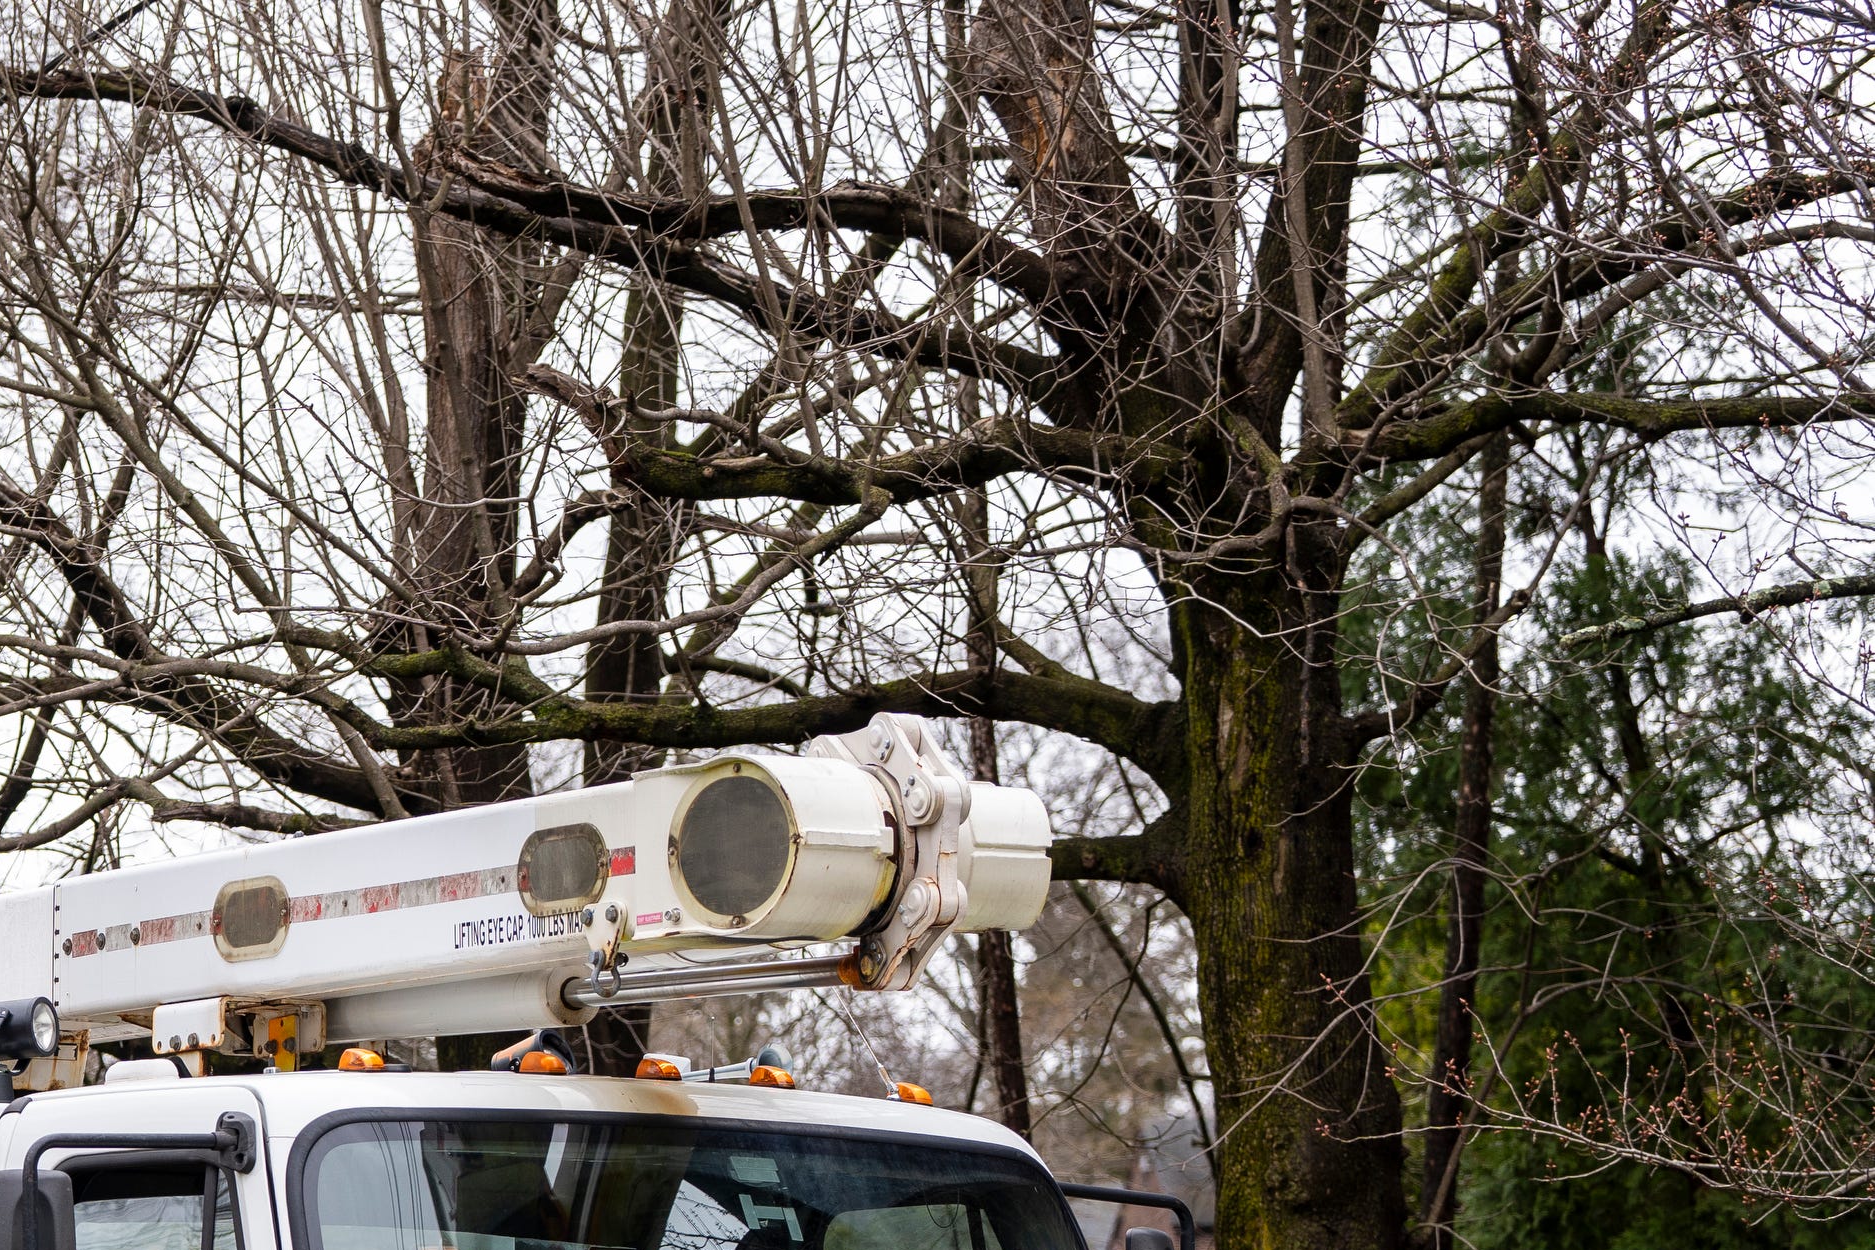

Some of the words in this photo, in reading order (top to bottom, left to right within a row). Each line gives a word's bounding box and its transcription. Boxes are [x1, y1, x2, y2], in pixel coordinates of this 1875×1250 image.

[454, 920, 485, 949] LIFTING
[488, 917, 504, 945] EYE
[506, 915, 525, 942] CAP.
[548, 909, 565, 937] LBS
